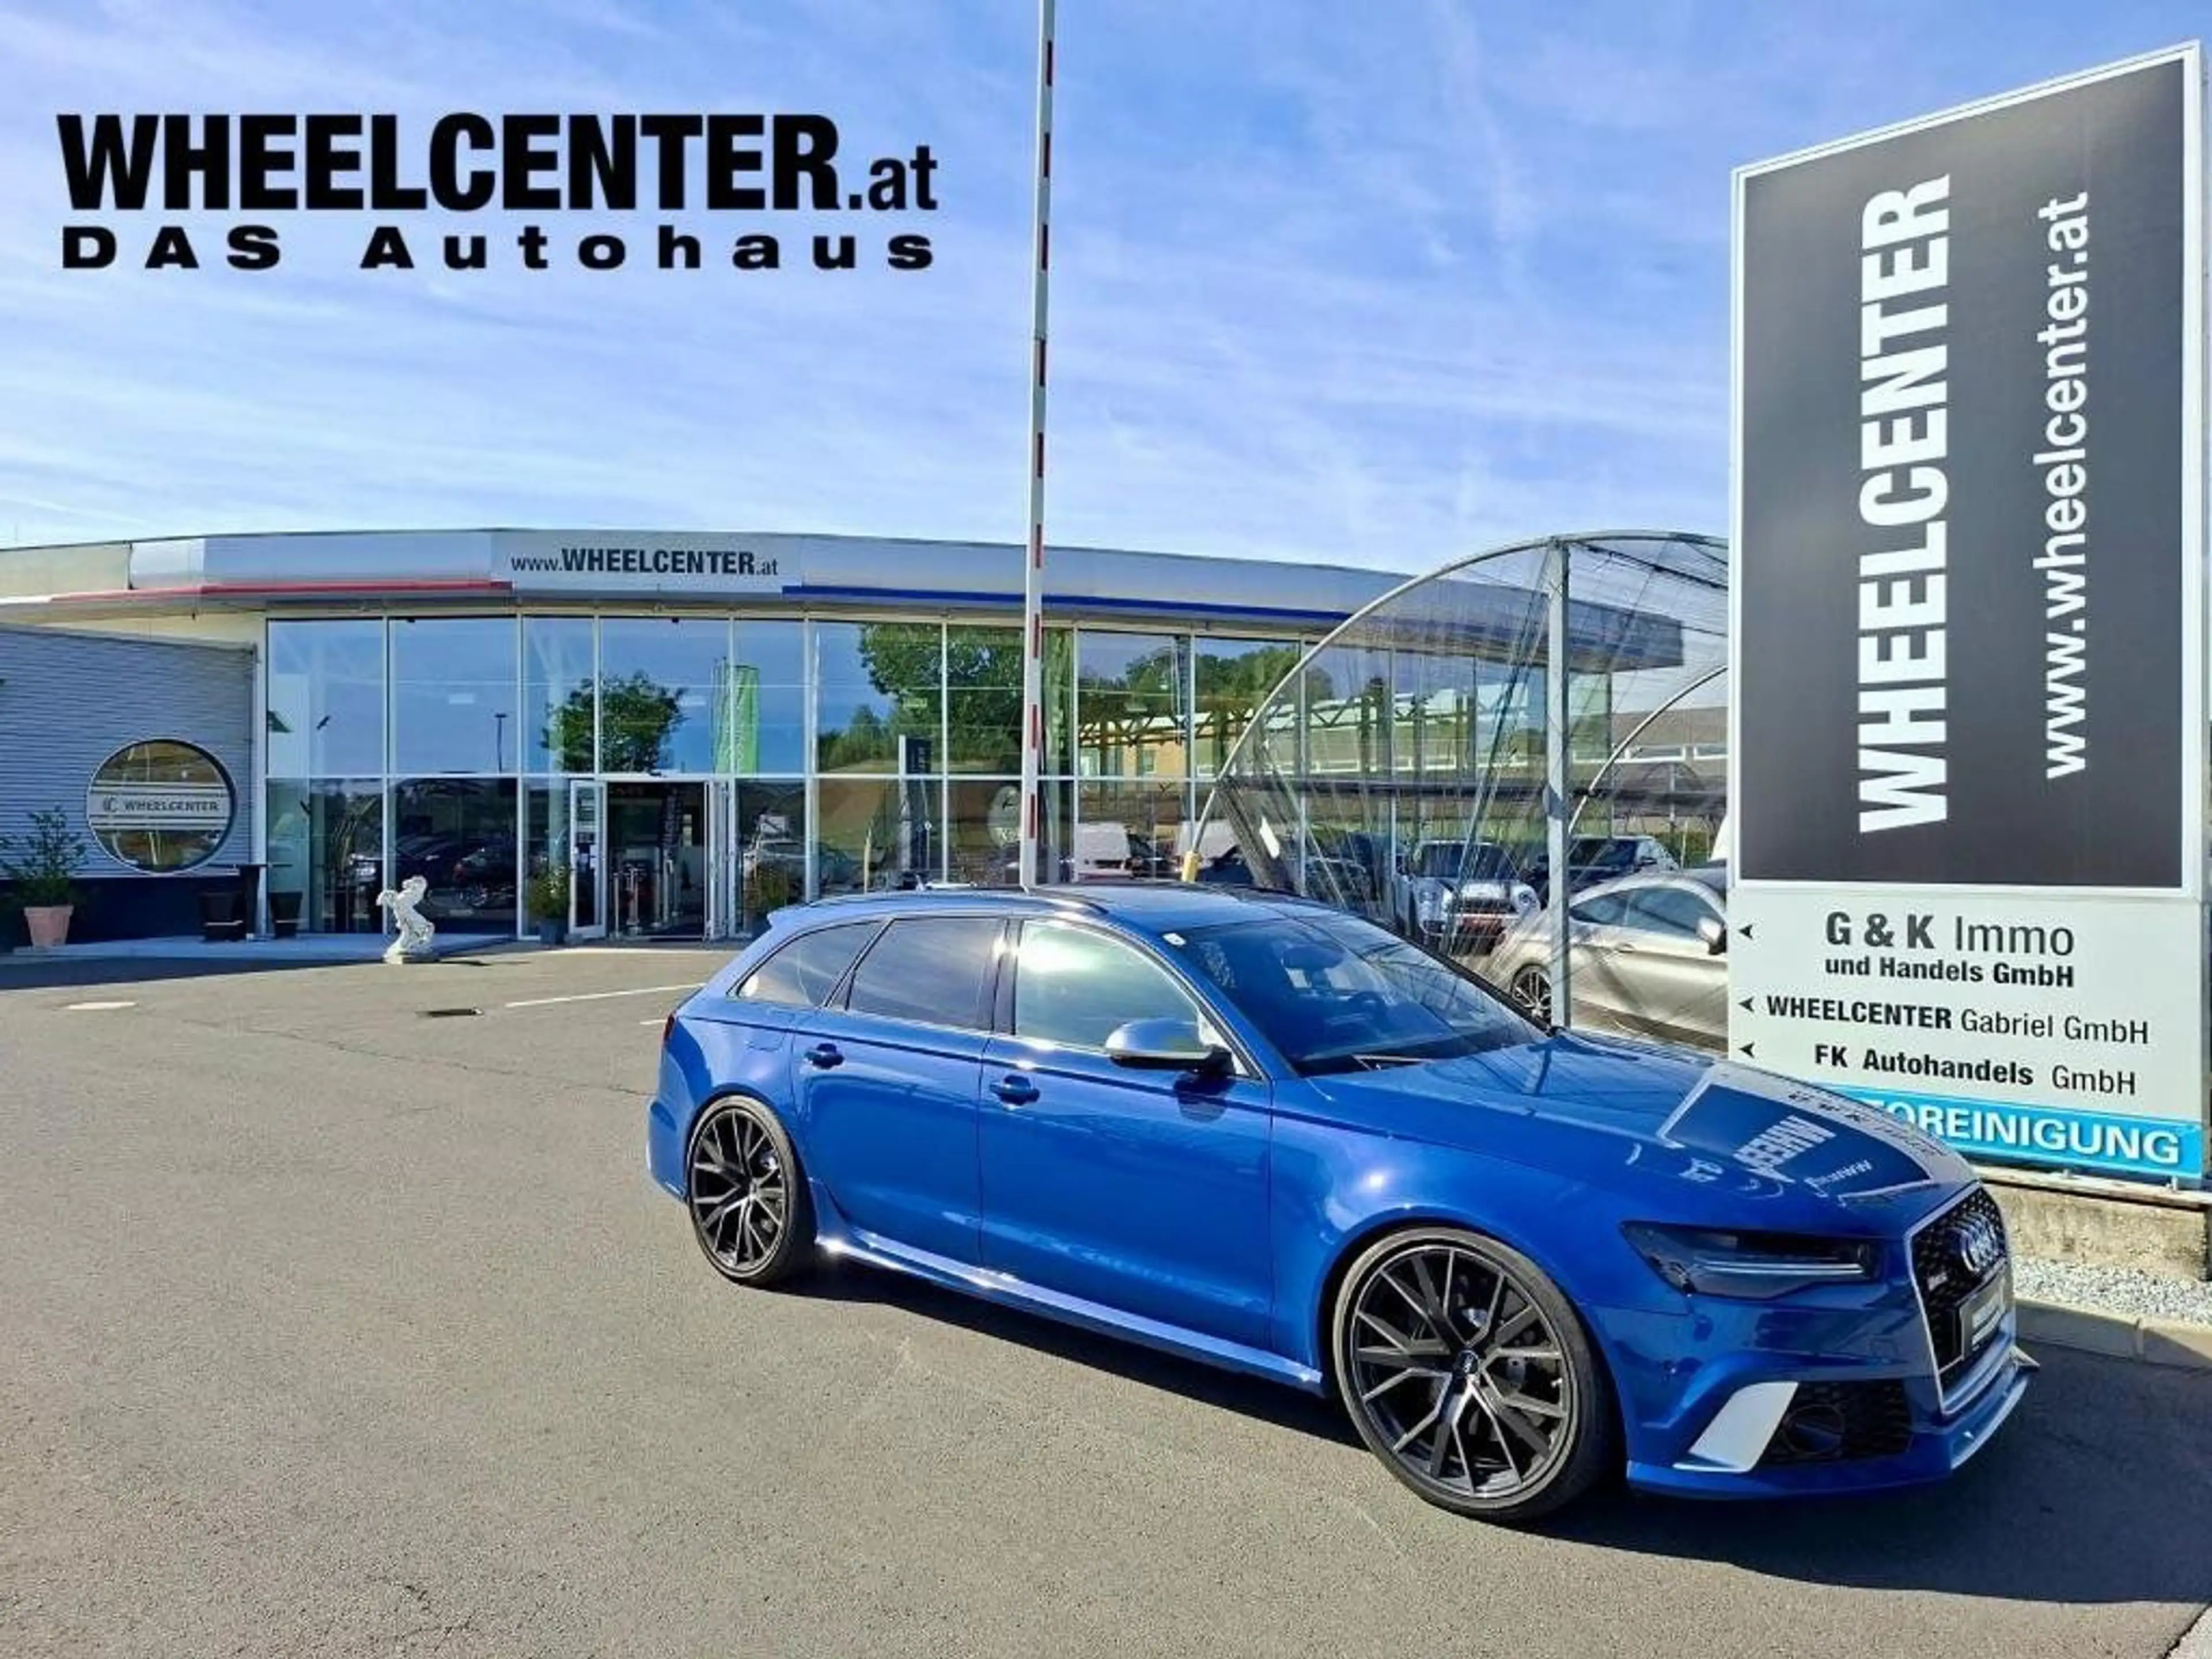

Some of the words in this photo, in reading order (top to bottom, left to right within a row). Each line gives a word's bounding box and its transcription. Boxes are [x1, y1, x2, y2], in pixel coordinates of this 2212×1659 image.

[1858, 173, 1950, 833] WHEELCENTER
[2033, 191, 2089, 779] www.wheelcenter.at
[511, 548, 778, 575] www.WHEELCENTER.at
[124, 799, 218, 812] WHEELCENTER
[1826, 911, 1851, 945] G
[1863, 913, 1895, 947] &
[1907, 914, 1935, 949] K
[1956, 916, 2074, 956] Immo
[1825, 956, 1870, 976] und
[1880, 957, 1984, 982] Handels
[1993, 962, 2074, 988] GmbH
[1767, 995, 1952, 1029] WHEELCENTER
[1961, 1008, 2053, 1038] Gabriel
[2064, 1015, 2148, 1044] GmbH
[1815, 1044, 1848, 1068] FK
[1862, 1049, 2033, 1086] Autohandels
[2052, 1065, 2135, 1096] GmbH
